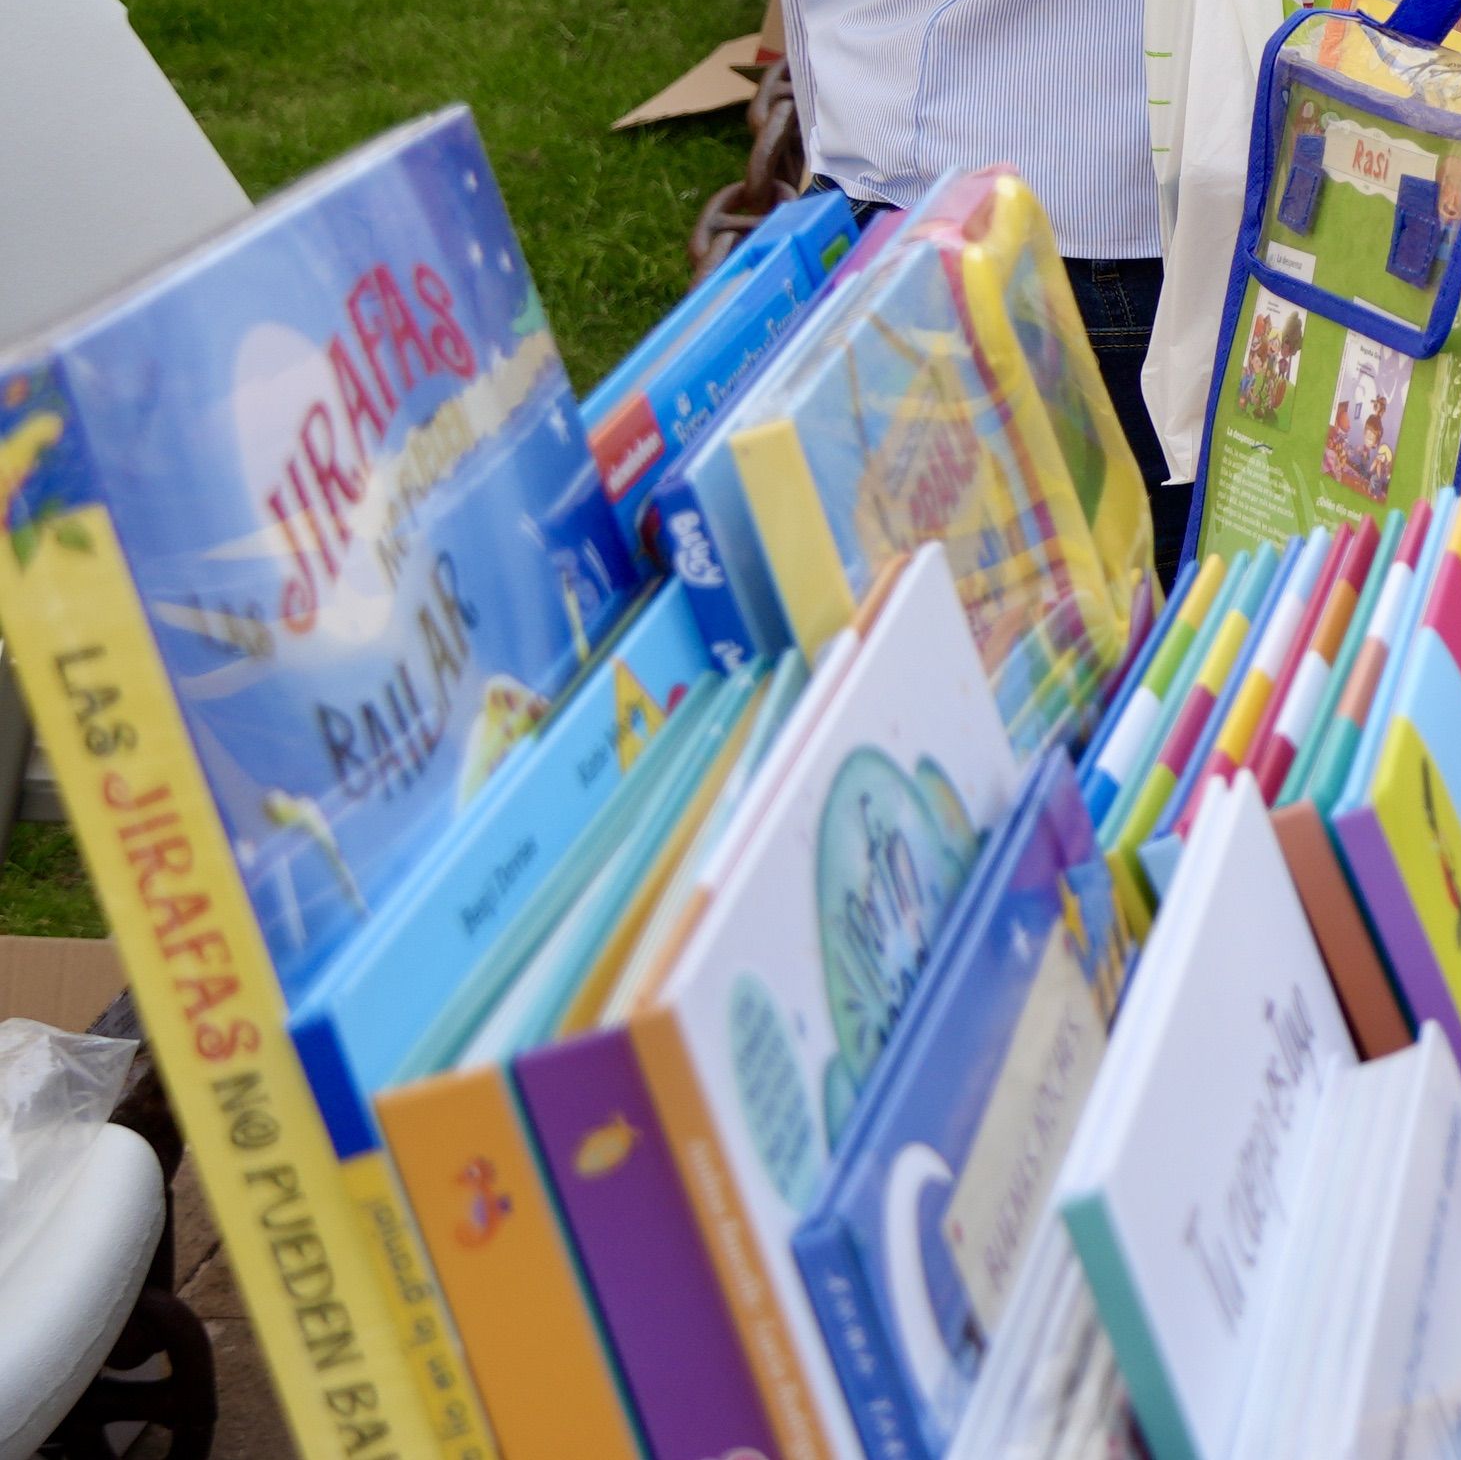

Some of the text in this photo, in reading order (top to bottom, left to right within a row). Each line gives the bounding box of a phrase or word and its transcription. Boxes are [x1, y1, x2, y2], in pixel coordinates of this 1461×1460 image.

[1351, 141, 1392, 182] Rasi
[265, 261, 478, 637] JIRAFAS
[52, 642, 139, 758] LAS
[102, 770, 261, 1067] JIRAFAS
[211, 1072, 281, 1154] NO
[243, 1164, 364, 1374] PUEDEN
